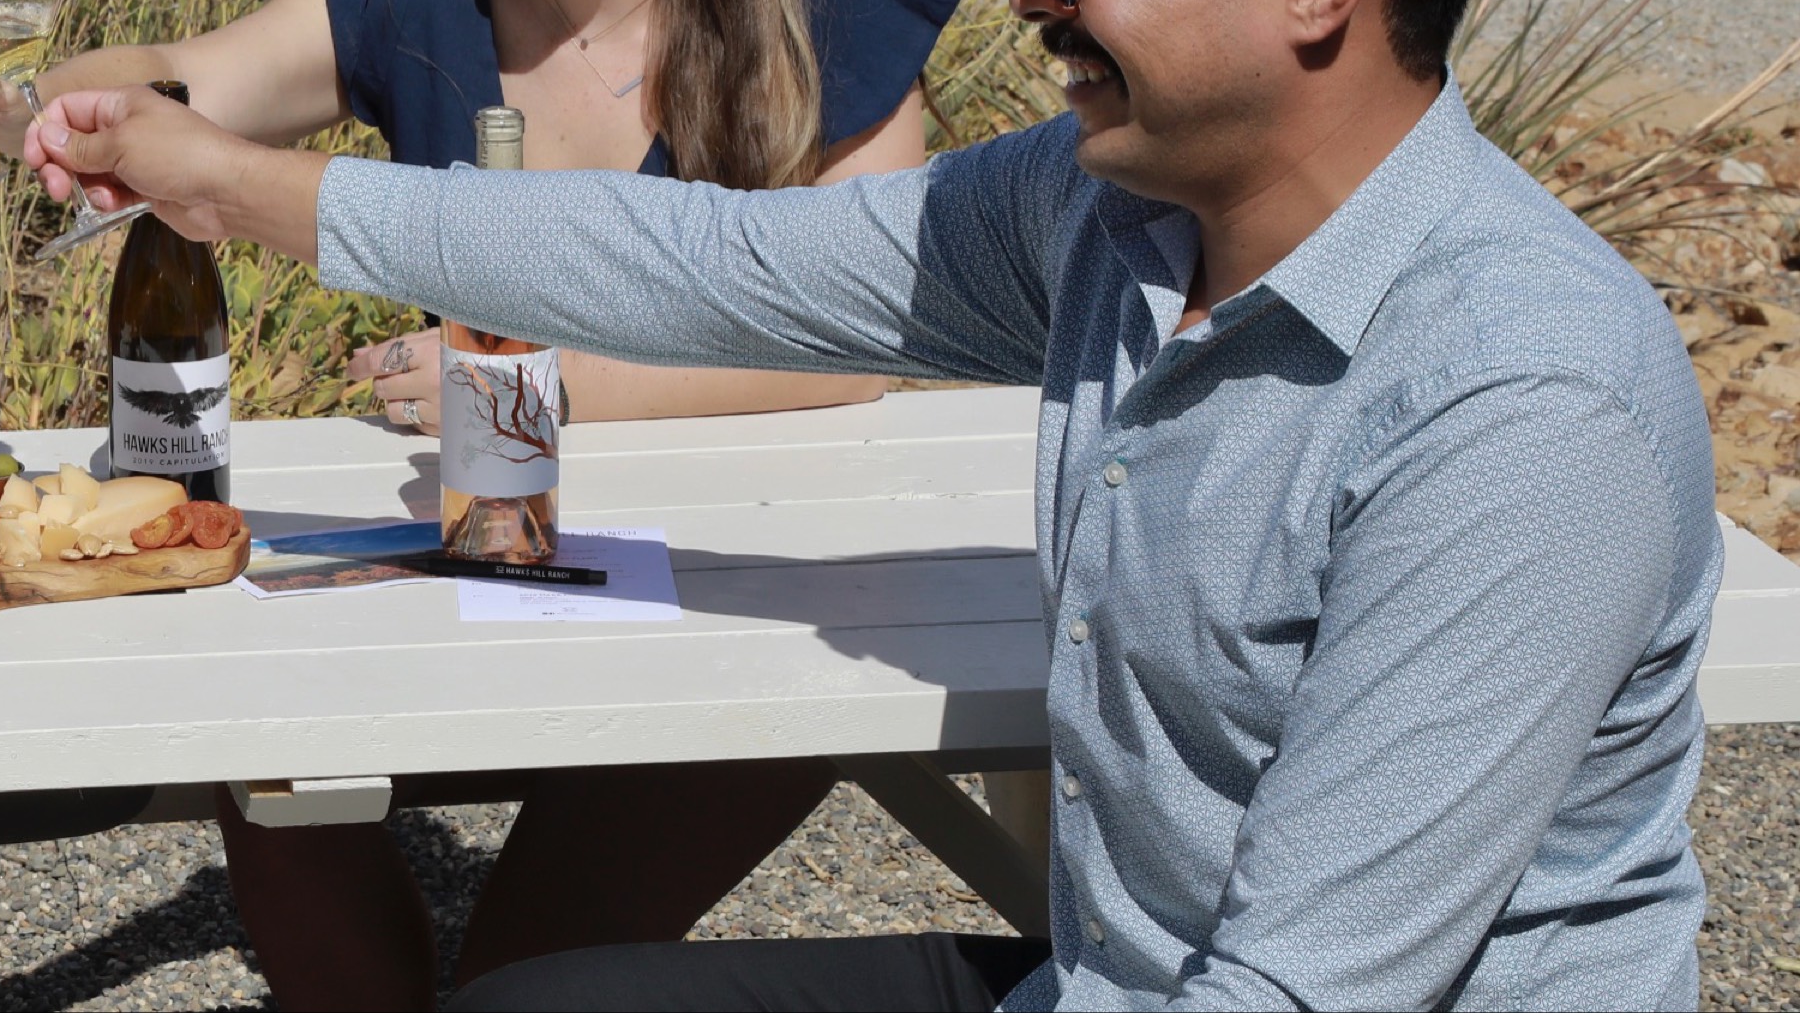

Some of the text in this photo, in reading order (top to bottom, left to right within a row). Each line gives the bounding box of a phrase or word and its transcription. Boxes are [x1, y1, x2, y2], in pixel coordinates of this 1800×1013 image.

[123, 433, 167, 454] HAWKS
[171, 435, 198, 454] HILL
[133, 451, 224, 465] 2019 CAPITULATION
[505, 567, 570, 579] HAWKS HILL RANCH
